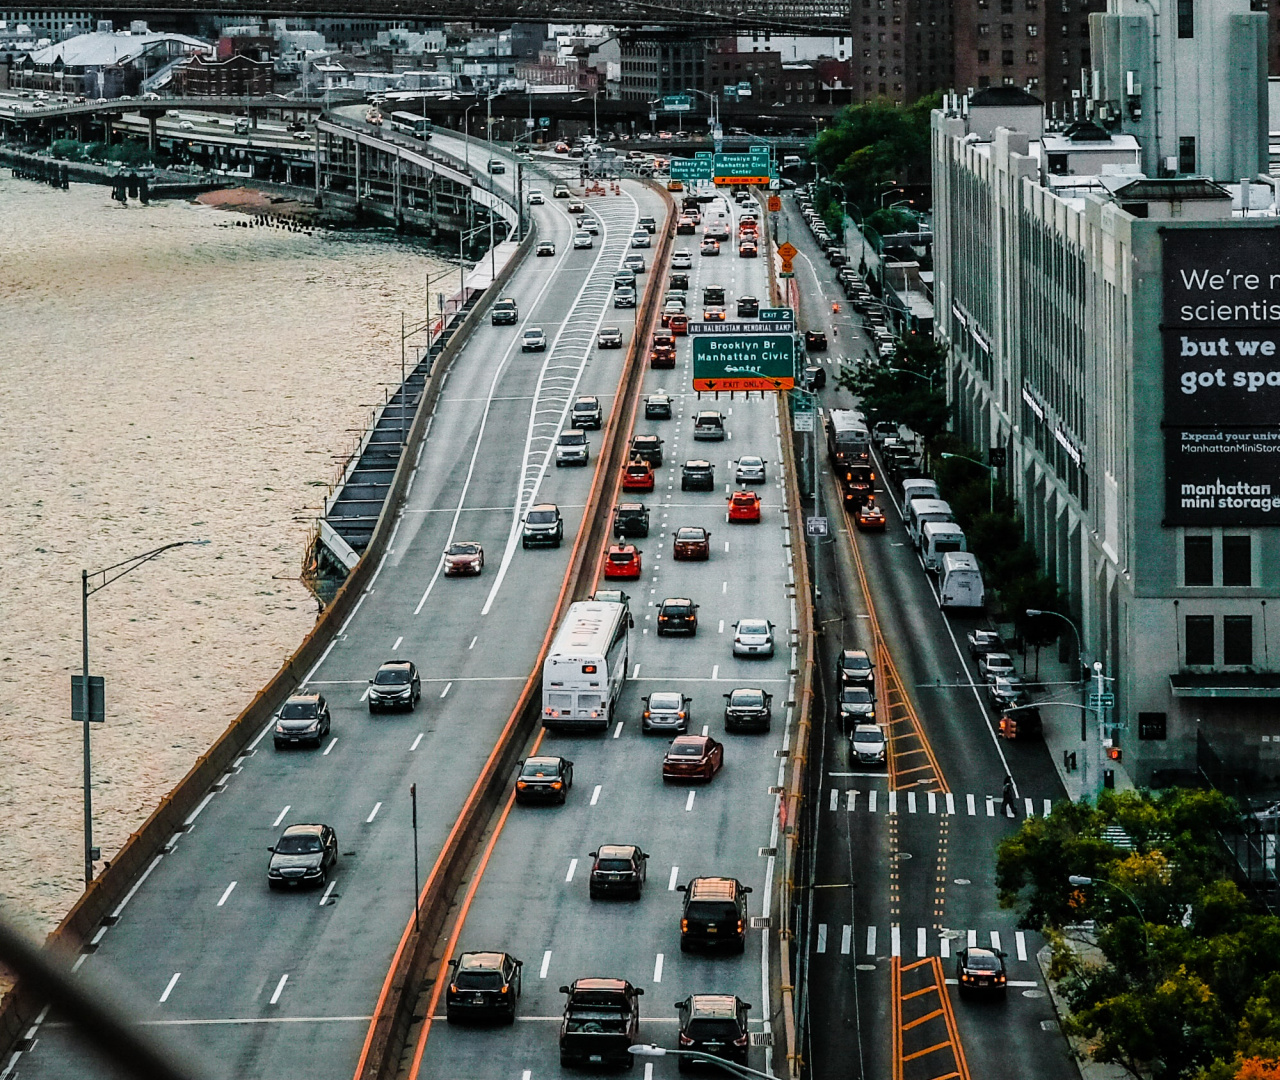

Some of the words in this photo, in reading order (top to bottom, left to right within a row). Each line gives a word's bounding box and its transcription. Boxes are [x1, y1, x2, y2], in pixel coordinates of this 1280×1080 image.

[1180, 269, 1260, 290] We're
[762, 311, 777, 319] EXIT
[782, 311, 790, 319] 2
[690, 323, 701, 332] ARI
[703, 323, 741, 332] HALBERSTAM
[743, 323, 772, 332] MEMORIAL
[775, 322, 792, 331] RAMP
[710, 341, 759, 351] Brooklyn
[764, 341, 776, 349] Br
[1180, 336, 1230, 357] but
[1235, 340, 1276, 356] we
[697, 352, 757, 361] Manhattan
[762, 352, 789, 360] Civic
[725, 364, 762, 373] Center
[1180, 369, 1226, 395] got
[1181, 432, 1223, 441] Expand
[1225, 433, 1250, 442] your
[1181, 477, 1271, 495] manhattan
[1181, 495, 1215, 508] mini
